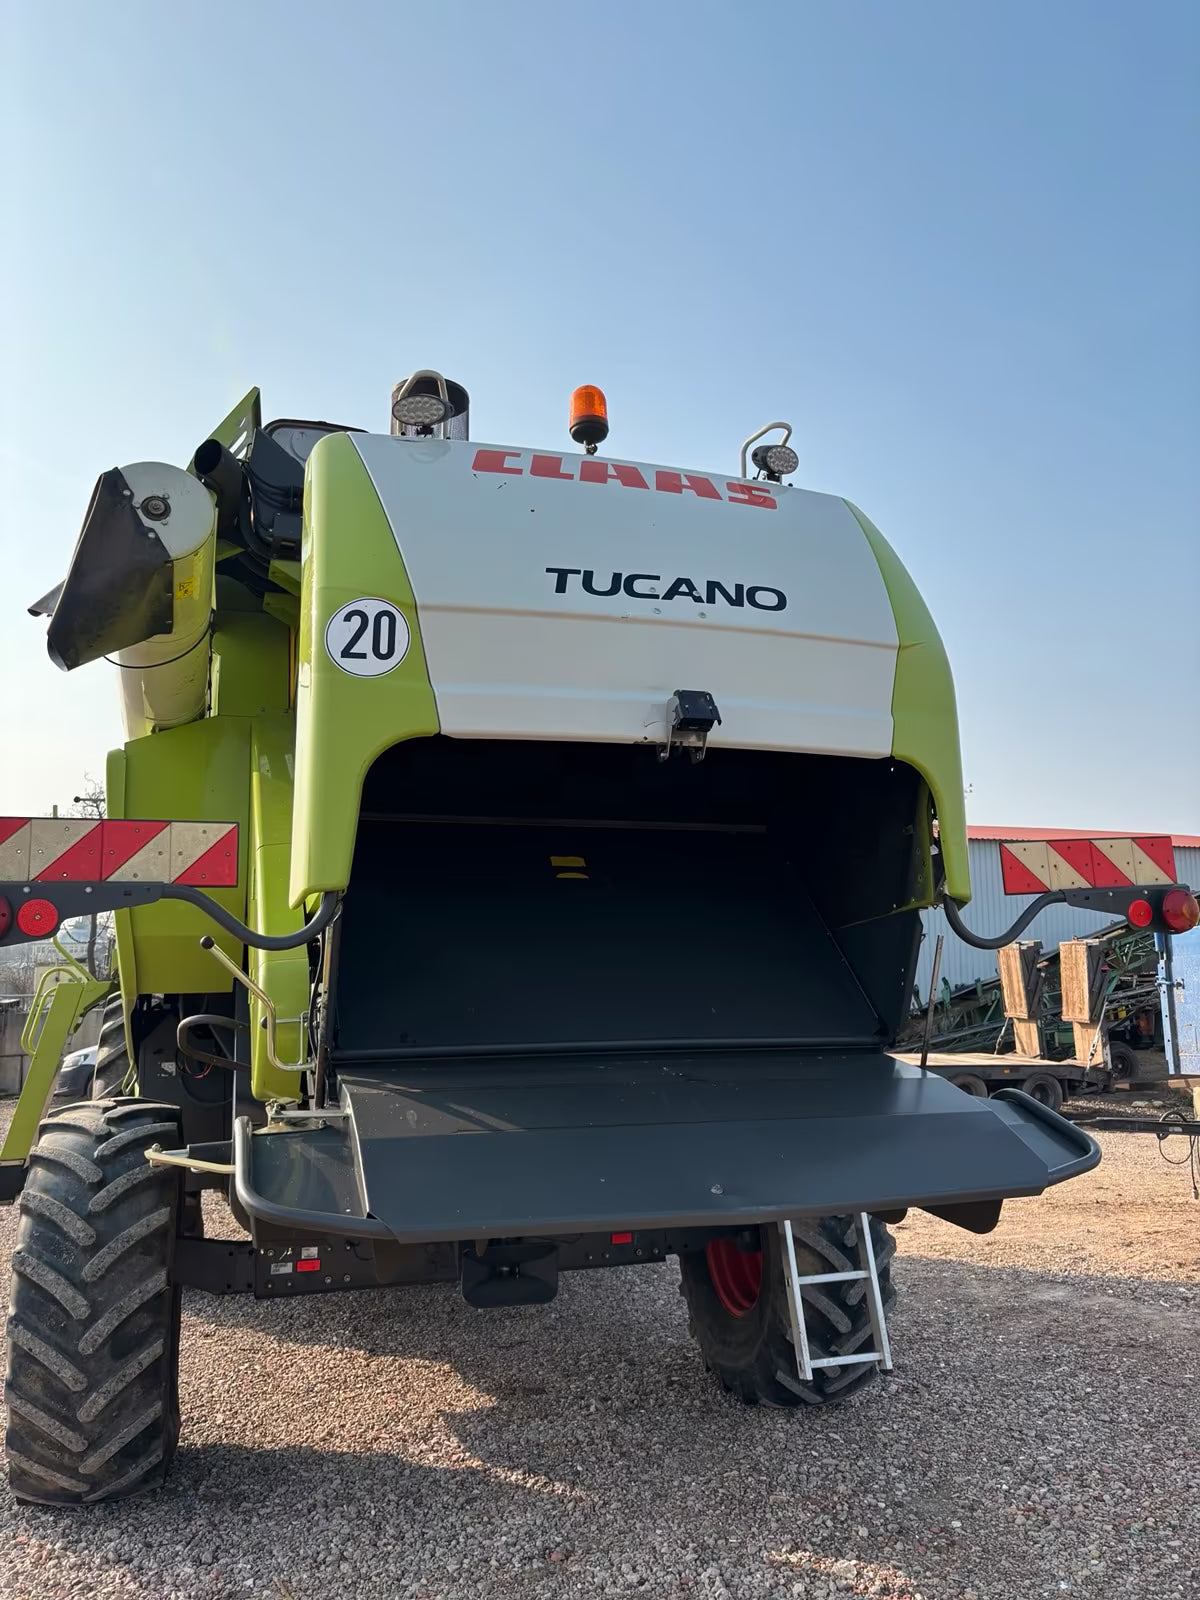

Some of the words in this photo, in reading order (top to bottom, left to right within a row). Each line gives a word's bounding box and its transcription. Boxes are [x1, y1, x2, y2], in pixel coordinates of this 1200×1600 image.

[472, 449, 777, 510] CLAAS
[545, 567, 787, 612] TUCANO
[340, 609, 396, 660] 20
